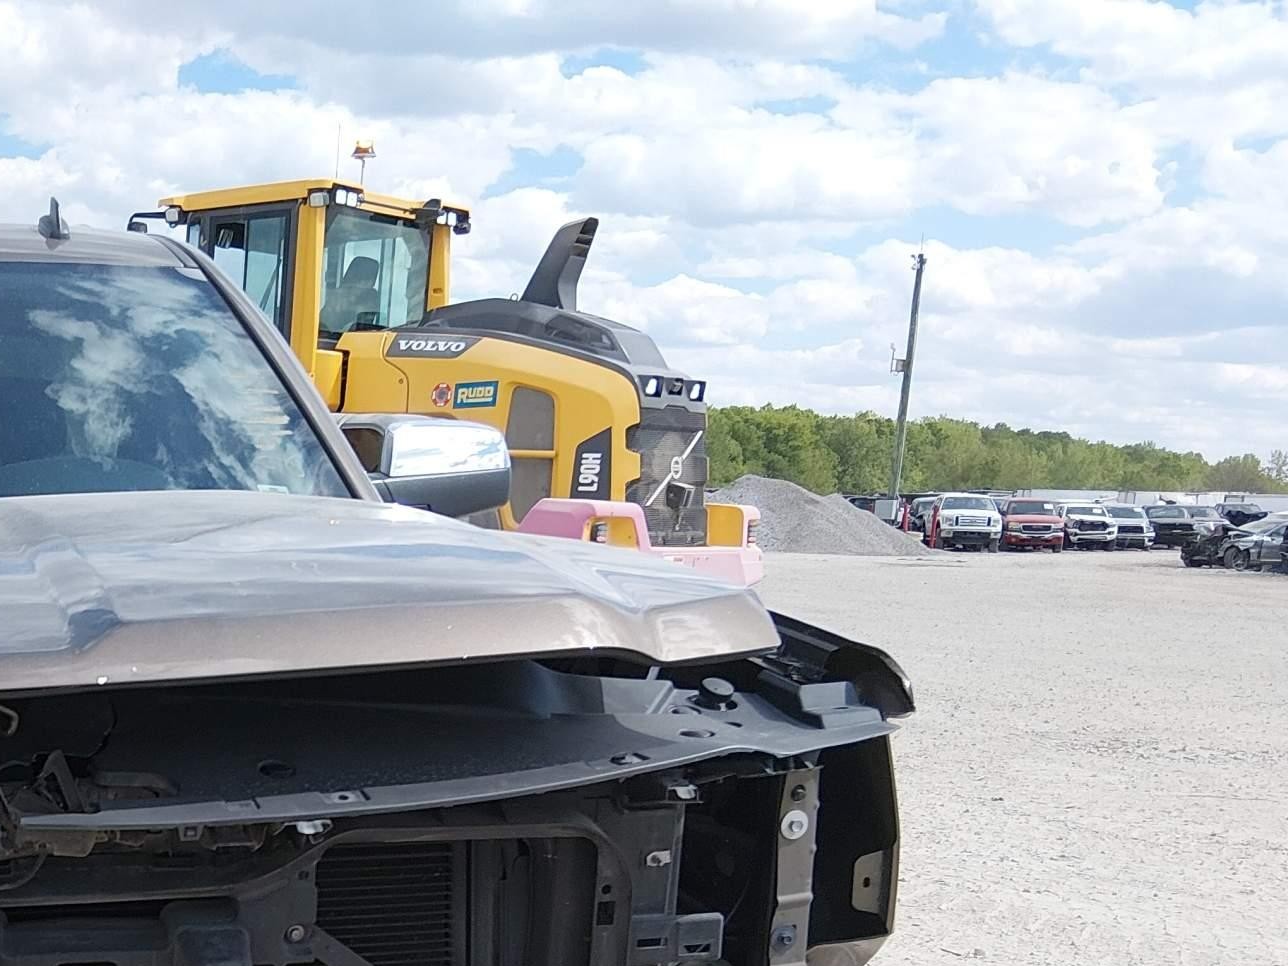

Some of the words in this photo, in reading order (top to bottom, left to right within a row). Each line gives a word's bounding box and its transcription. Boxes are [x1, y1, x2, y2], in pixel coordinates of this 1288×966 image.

[398, 340, 467, 352] VOLVO
[456, 385, 496, 404] RUDD
[577, 452, 603, 492] L90H
